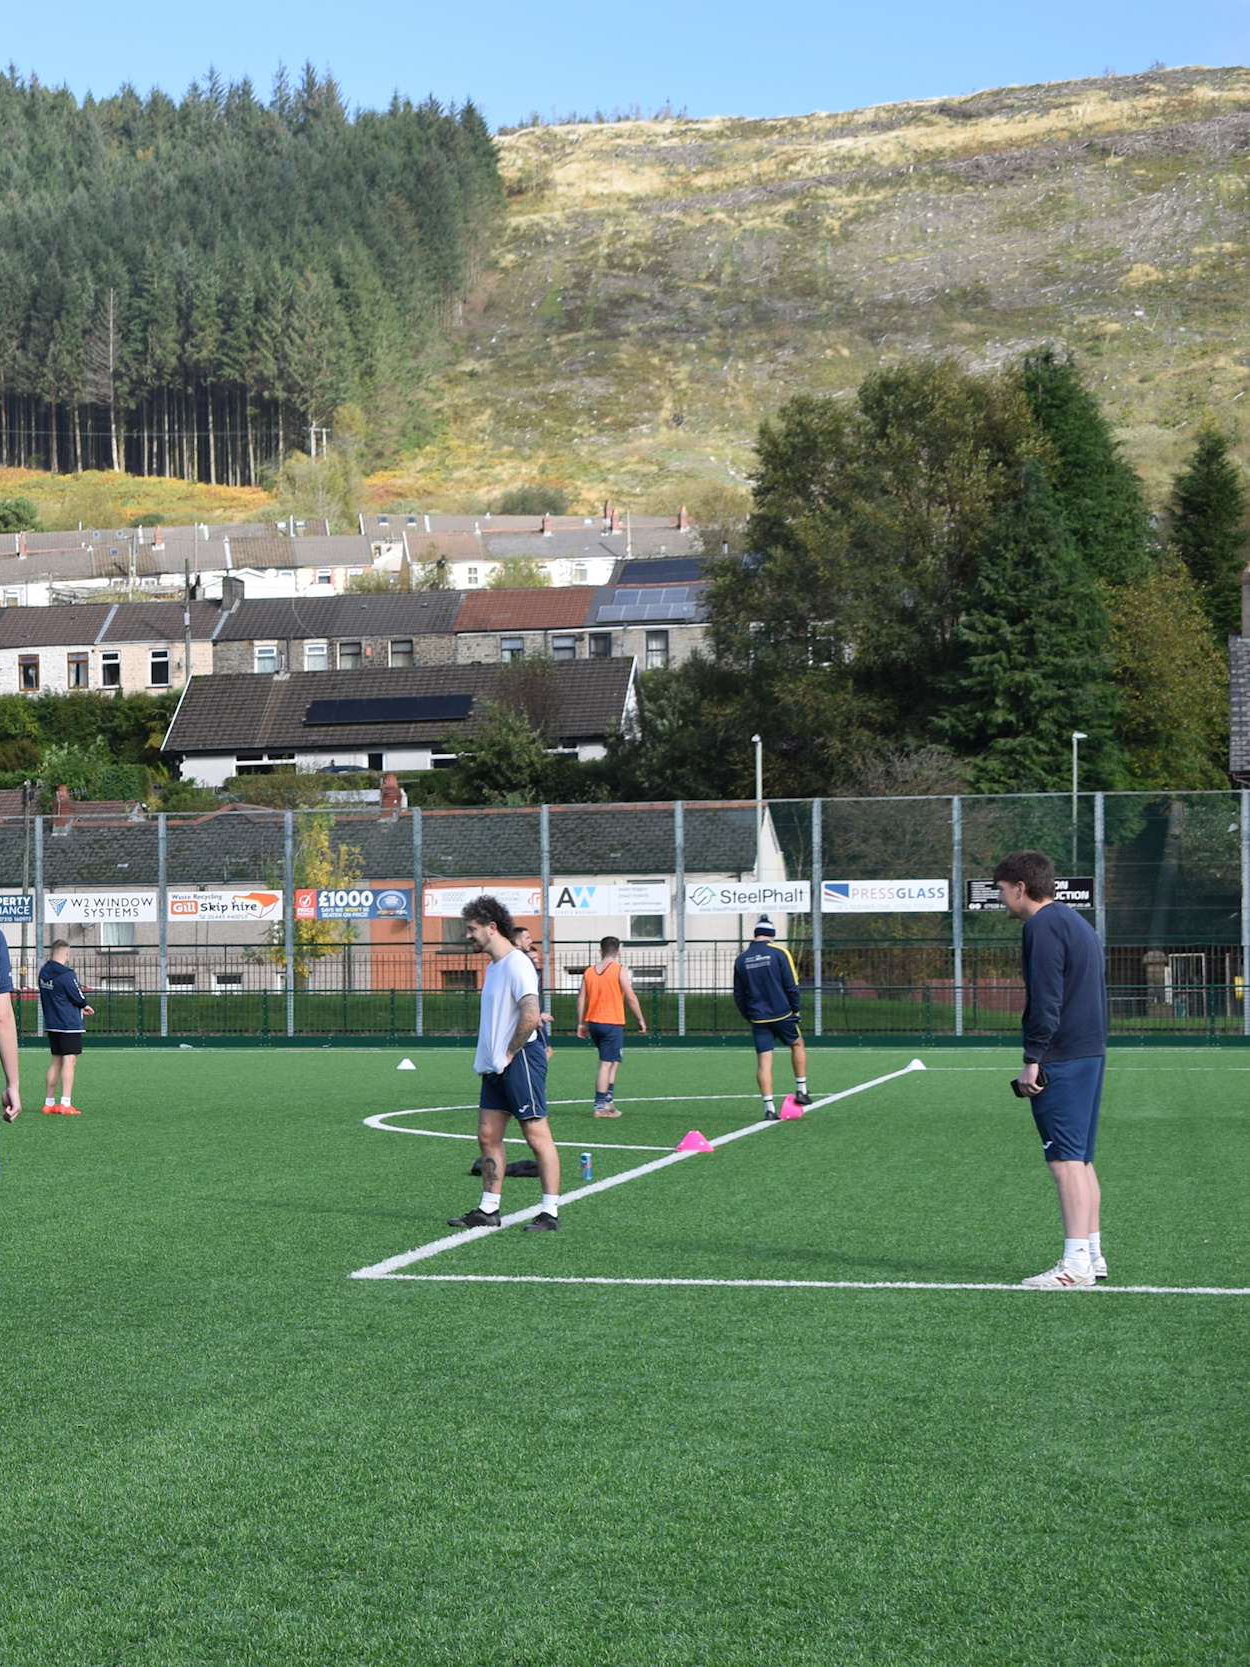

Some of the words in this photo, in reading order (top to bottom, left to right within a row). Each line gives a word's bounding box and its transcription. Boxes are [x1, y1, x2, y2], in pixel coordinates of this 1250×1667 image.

[318, 890, 374, 907] £1000
[720, 889, 803, 904] SteelPhalt
[851, 888, 945, 899] PRESSGLASS
[71, 899, 90, 907] W2
[94, 898, 153, 907] WINDOW
[172, 902, 197, 913] Gill
[200, 902, 228, 913] Skip
[232, 901, 257, 912] hire
[84, 908, 139, 917] SYSTEMS
